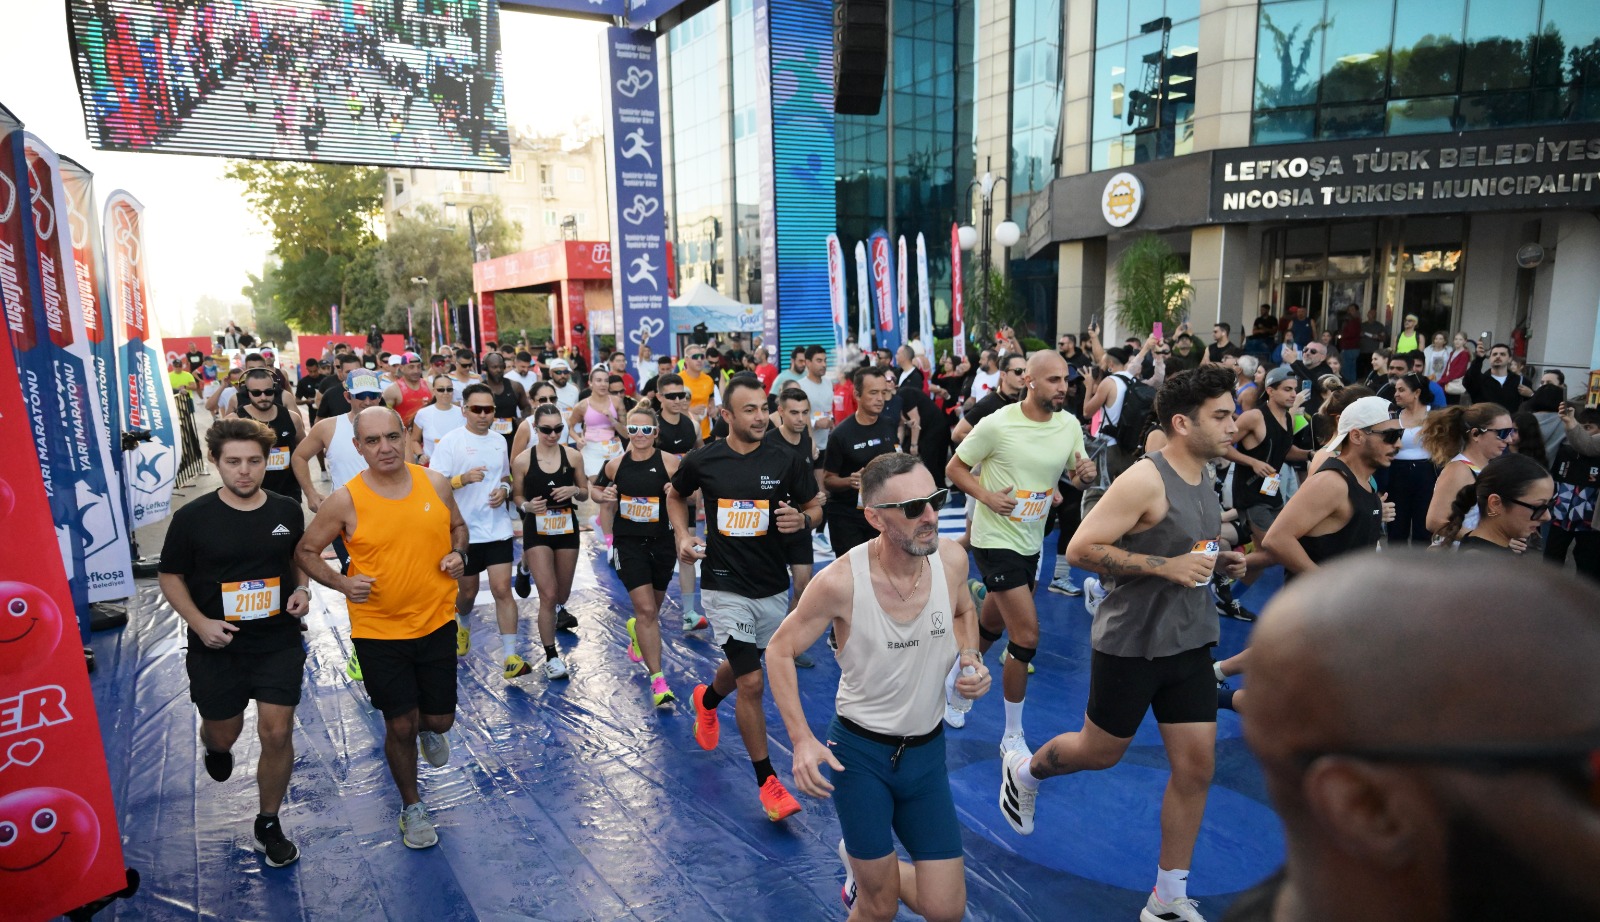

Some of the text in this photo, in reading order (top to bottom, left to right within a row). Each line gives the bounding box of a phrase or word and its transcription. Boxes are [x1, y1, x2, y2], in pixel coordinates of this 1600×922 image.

[1224, 155, 1344, 182] LEFKOŞA
[1353, 147, 1431, 173] TÜRK
[1222, 188, 1314, 211] NICOSIA
[1320, 181, 1424, 206] TURKISH
[64, 363, 86, 440] MARATONU
[97, 357, 110, 424] MARATONU
[128, 374, 140, 426] ÜLKER
[143, 353, 163, 430] YARI MARATONU
[26, 369, 49, 461] MARATONU
[77, 442, 92, 471] YARI
[627, 503, 653, 518] 21025
[725, 511, 761, 529] 21073
[236, 590, 272, 613] 21139
[894, 640, 920, 649] BANDIT
